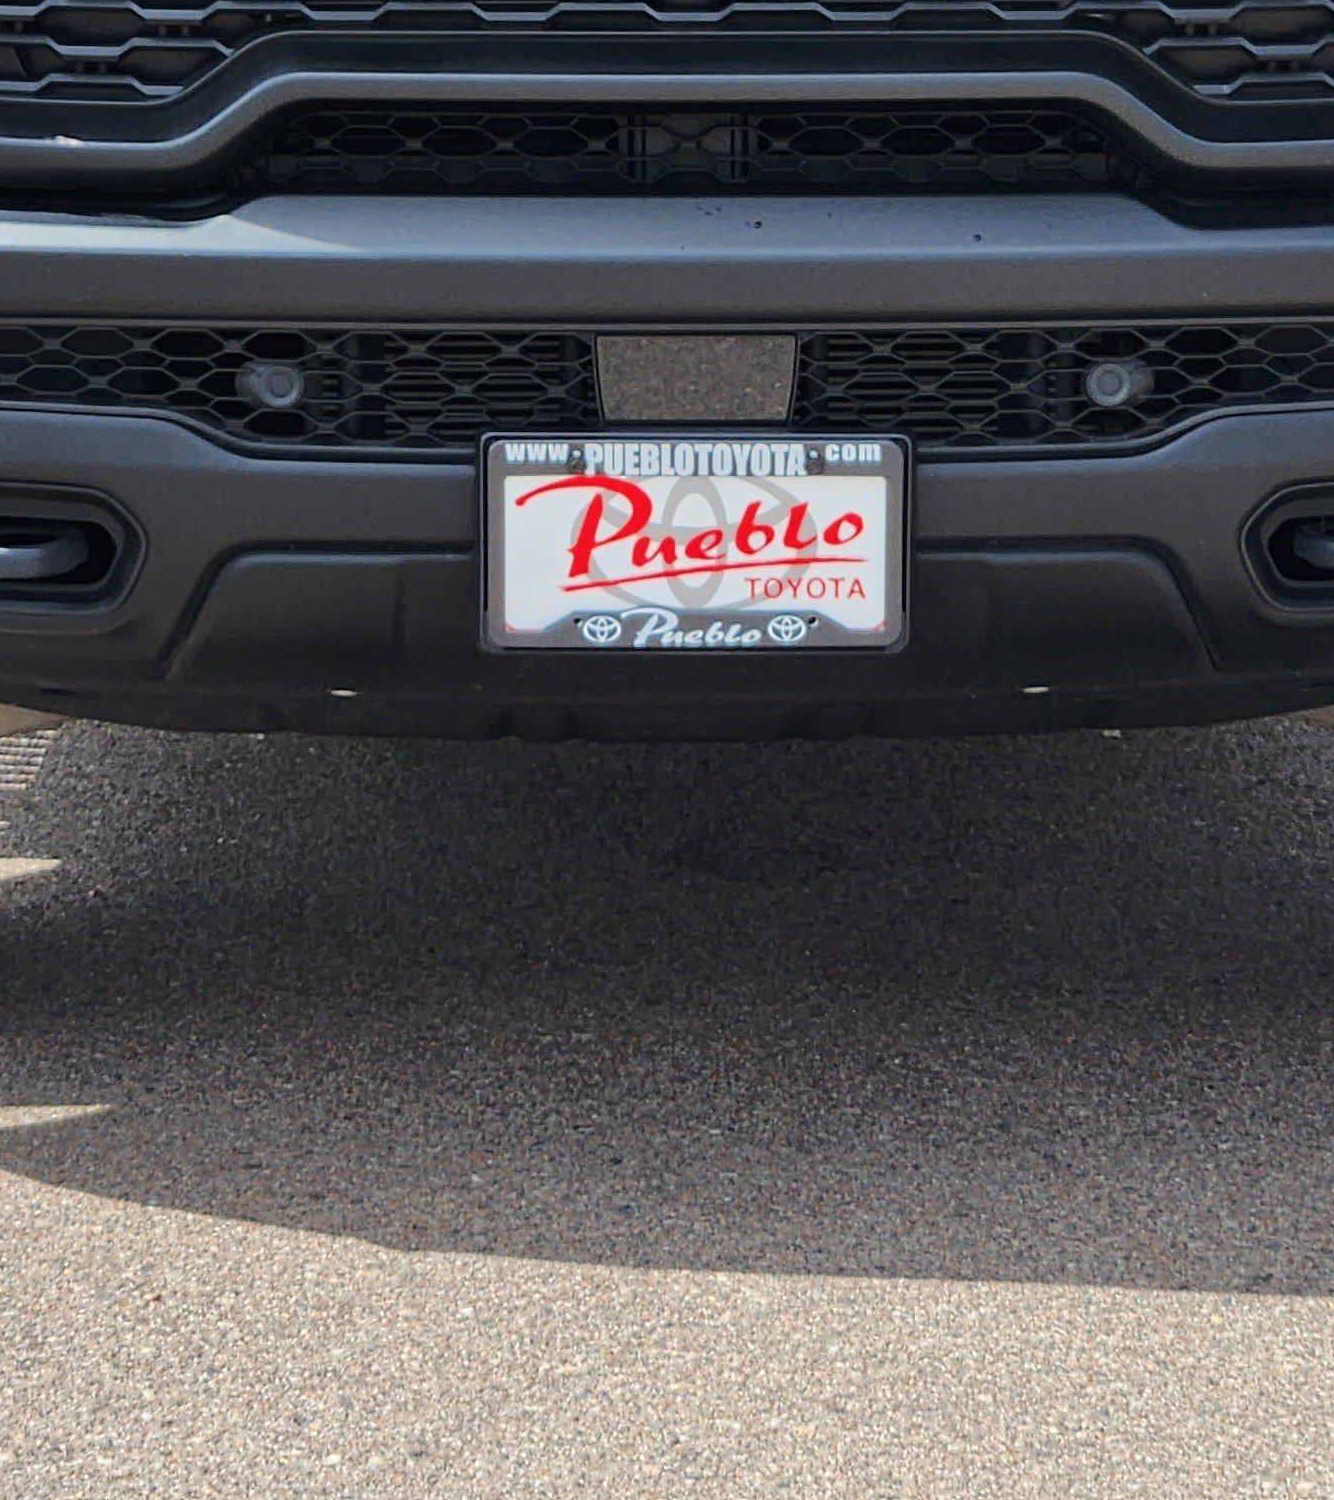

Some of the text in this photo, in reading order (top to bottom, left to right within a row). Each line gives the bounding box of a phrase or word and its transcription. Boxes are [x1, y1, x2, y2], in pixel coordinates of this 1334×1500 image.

[515, 474, 865, 578] Pueblo
[745, 577, 867, 600] TOYOTA
[620, 606, 762, 648] Pueblo
